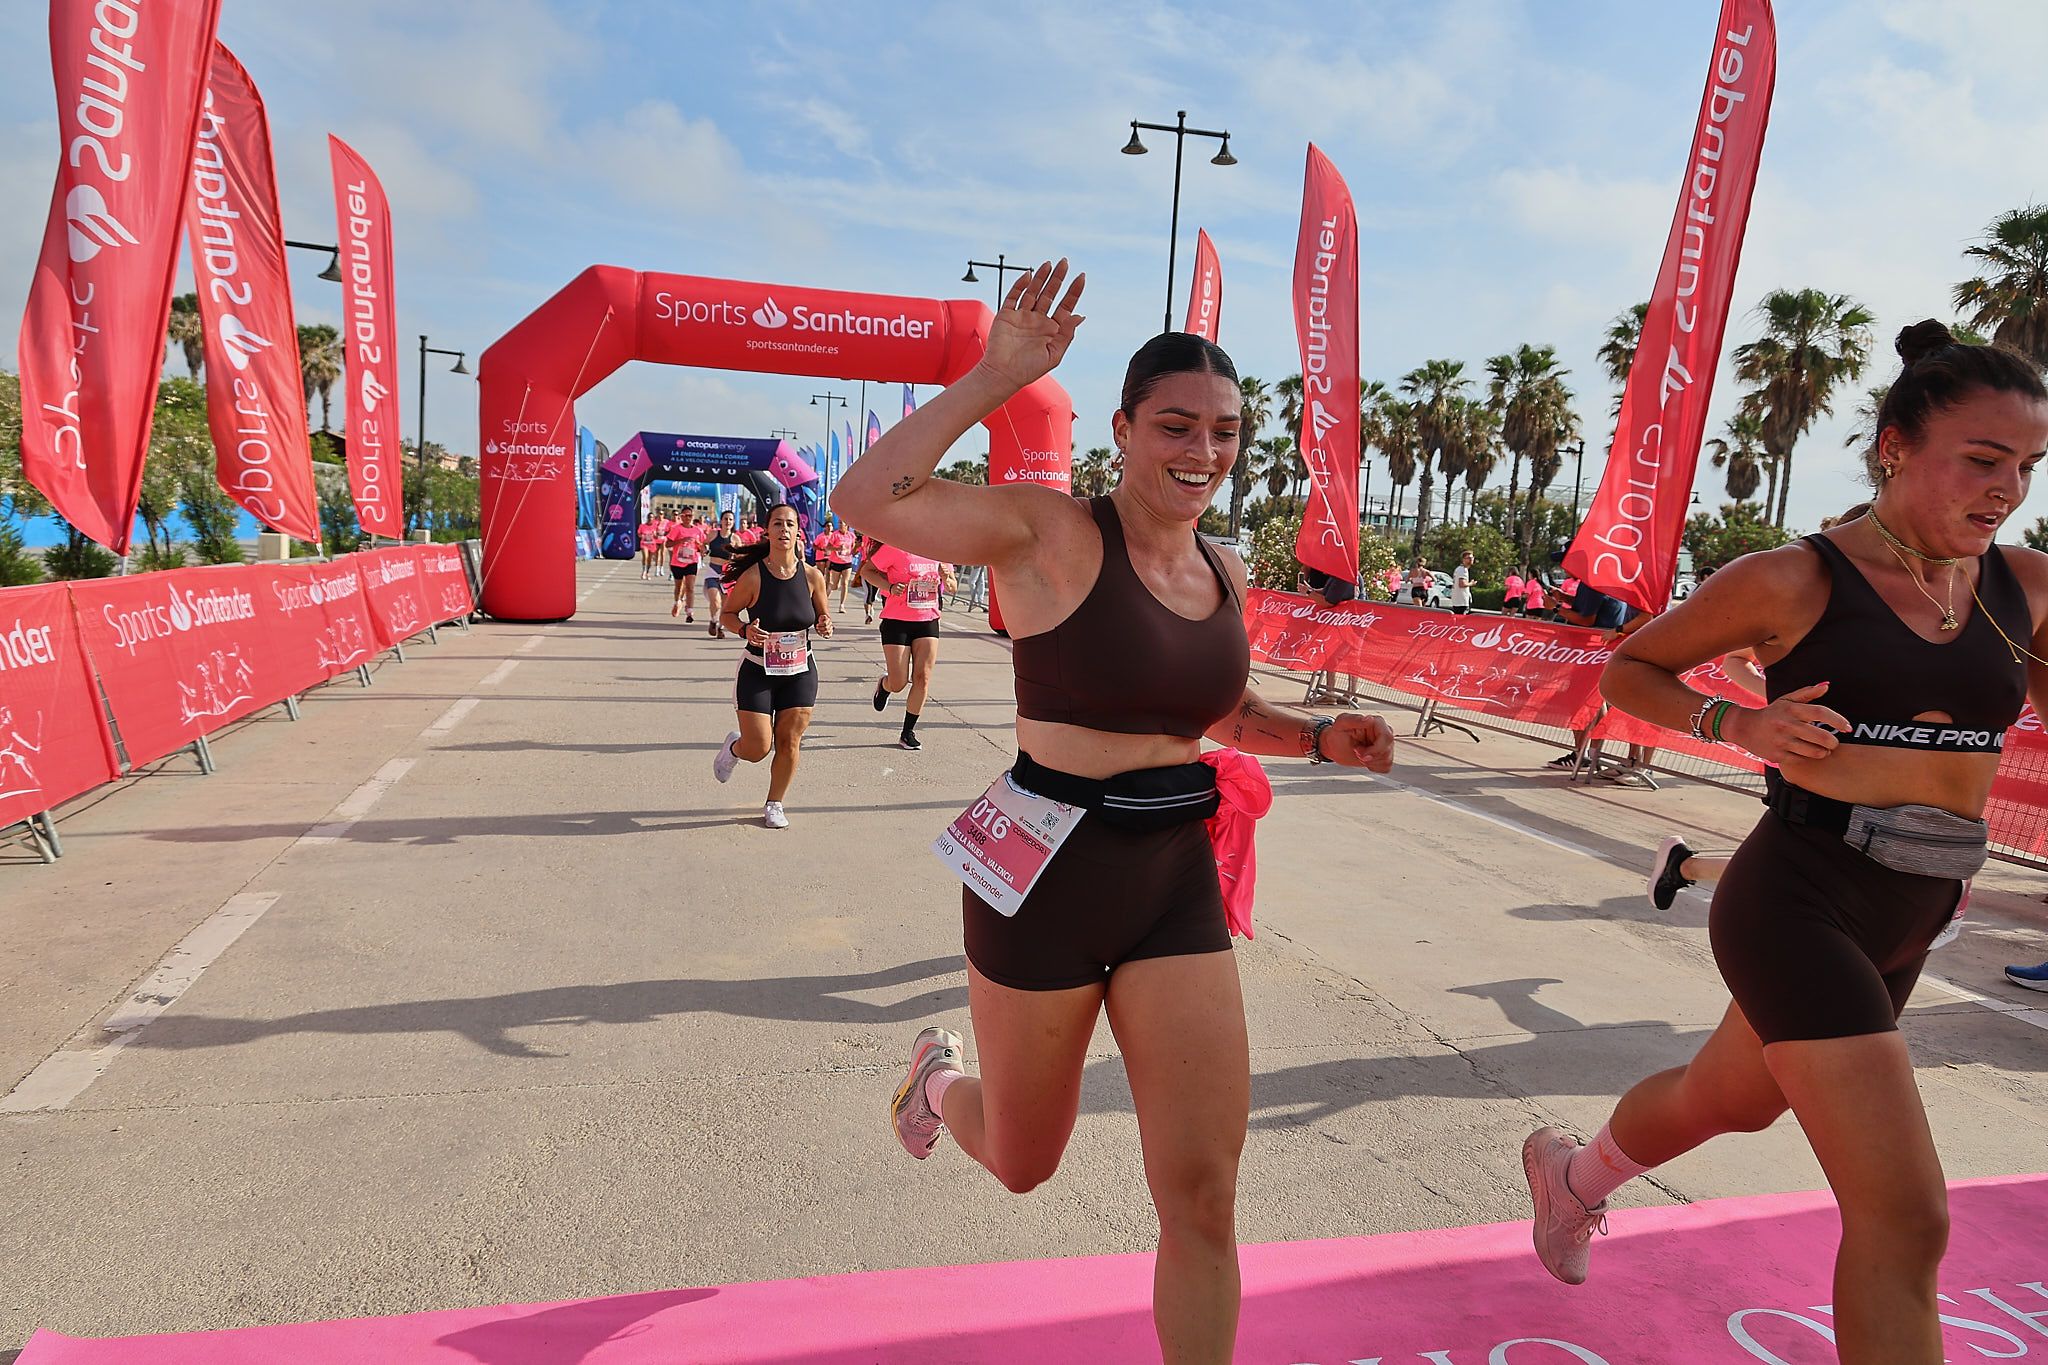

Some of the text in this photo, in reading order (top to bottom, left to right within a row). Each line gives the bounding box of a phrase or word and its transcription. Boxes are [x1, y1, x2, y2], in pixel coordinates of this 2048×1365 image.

[655, 292, 933, 339] Sports Santander
[746, 339, 839, 355] sportssantander.es
[503, 419, 547, 435] Sports
[500, 441, 566, 456] Santander
[1023, 448, 1059, 463] Sports
[1020, 469, 1070, 482] Santander
[272, 580, 312, 618] Sports
[103, 587, 256, 656] Sports Santander
[1256, 596, 1383, 628] Sports Santander
[1408, 620, 1474, 643] Sports
[781, 652, 798, 660] 016
[1853, 723, 1931, 744] NIKE
[1936, 729, 1990, 747] PRO
[971, 798, 1011, 839] 016
[967, 825, 987, 845] 3408
[986, 857, 1015, 884] VALENCIA
[969, 867, 1004, 900] Santander
